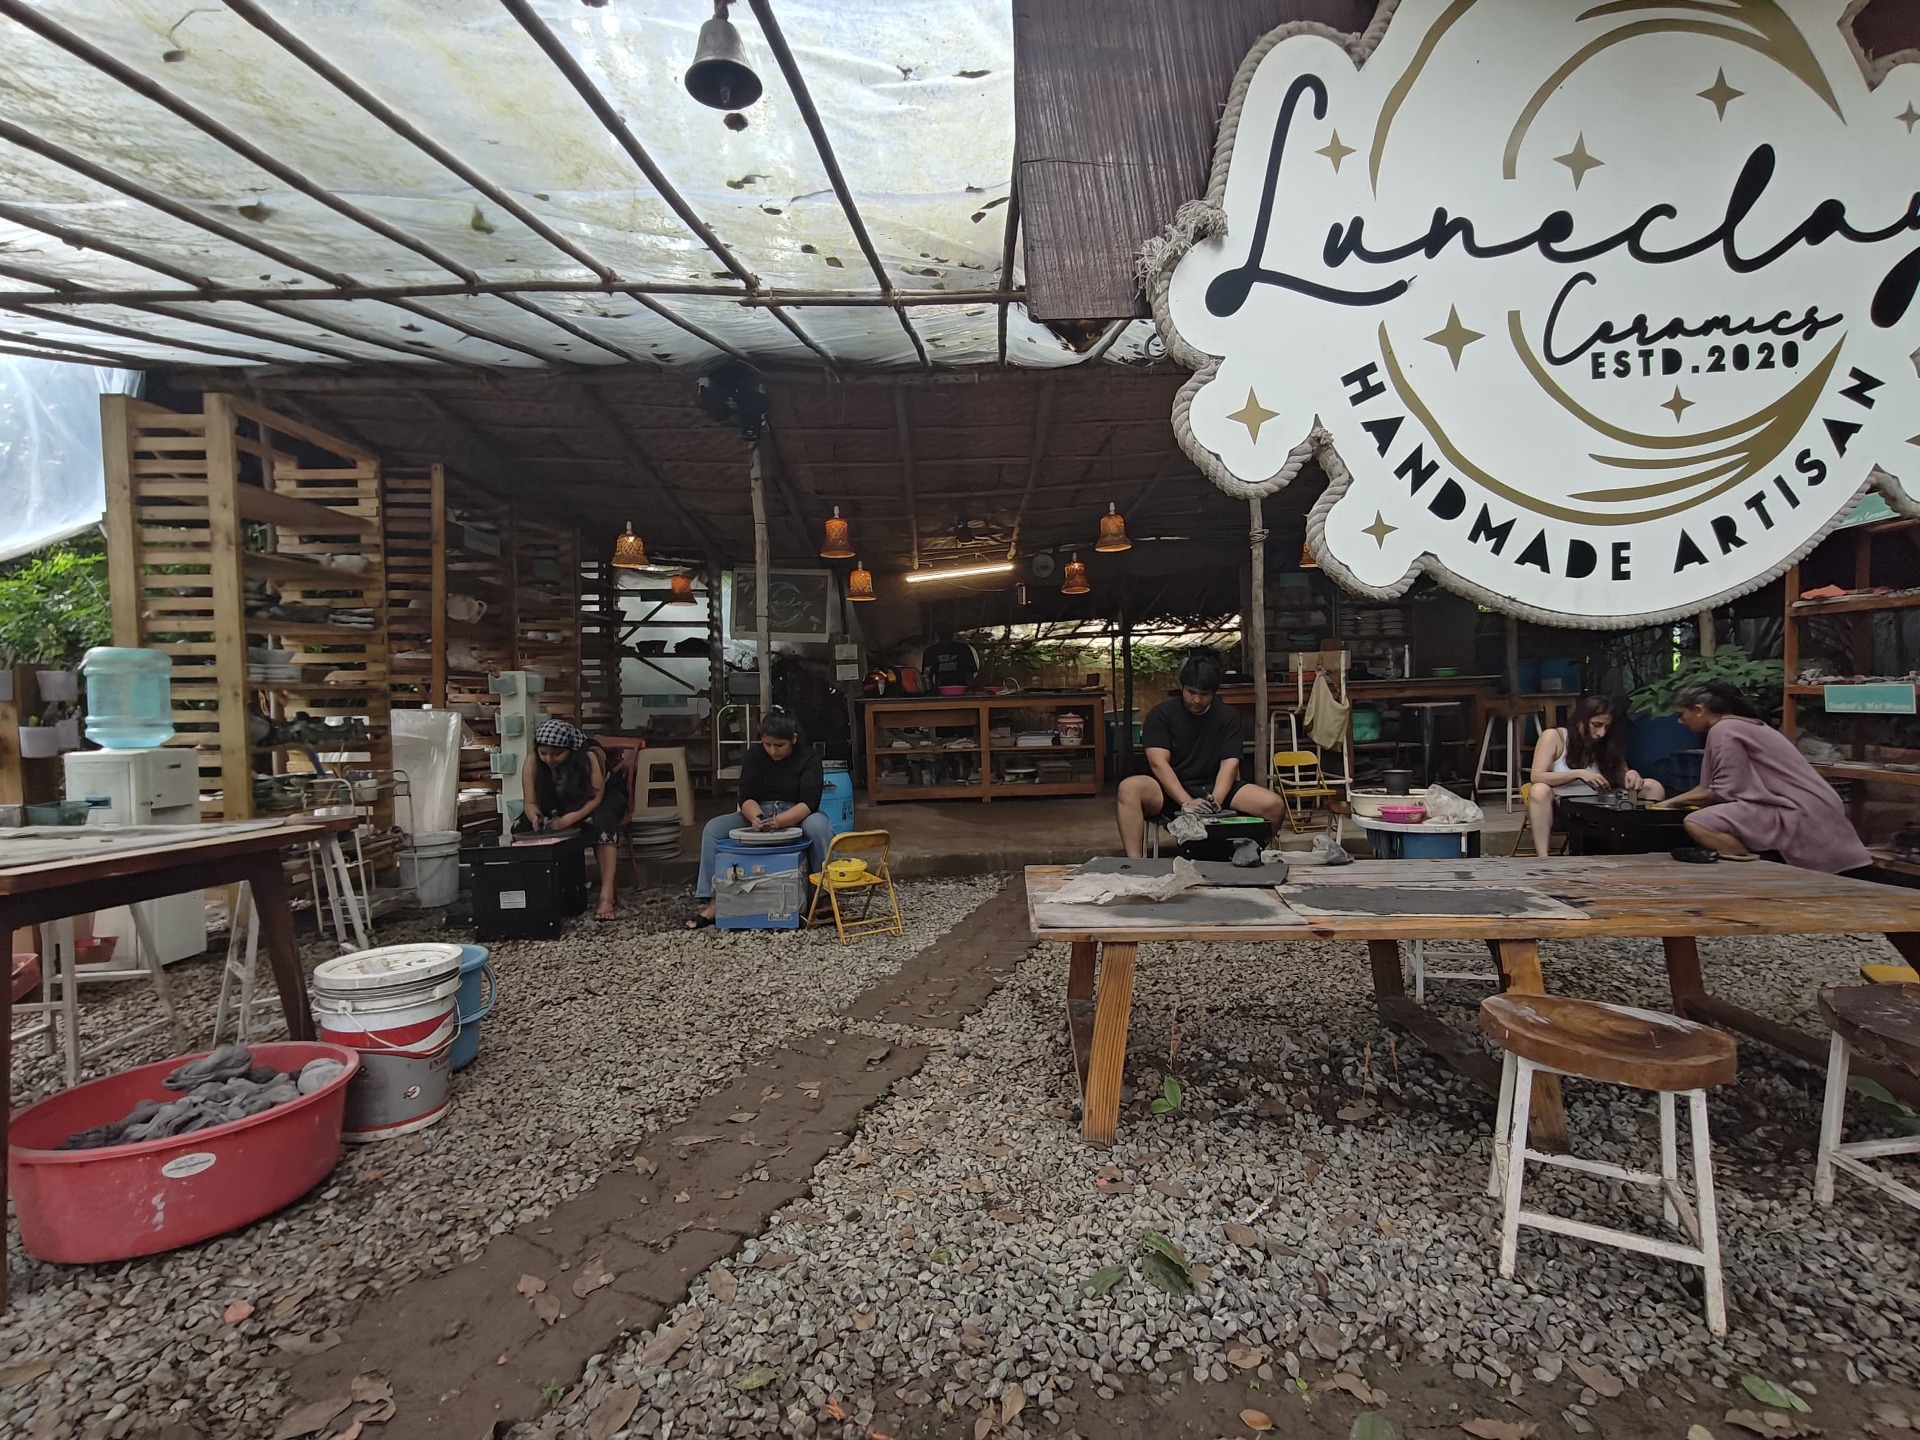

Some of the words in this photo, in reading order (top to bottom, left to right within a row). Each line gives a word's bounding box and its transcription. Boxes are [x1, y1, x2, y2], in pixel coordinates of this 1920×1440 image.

[1543, 271, 1844, 366] Ceramics
[1591, 340, 1799, 380] ESTD.2020
[1340, 361, 1632, 581] HANDMADE
[1673, 366, 1886, 574] ARTISAN
